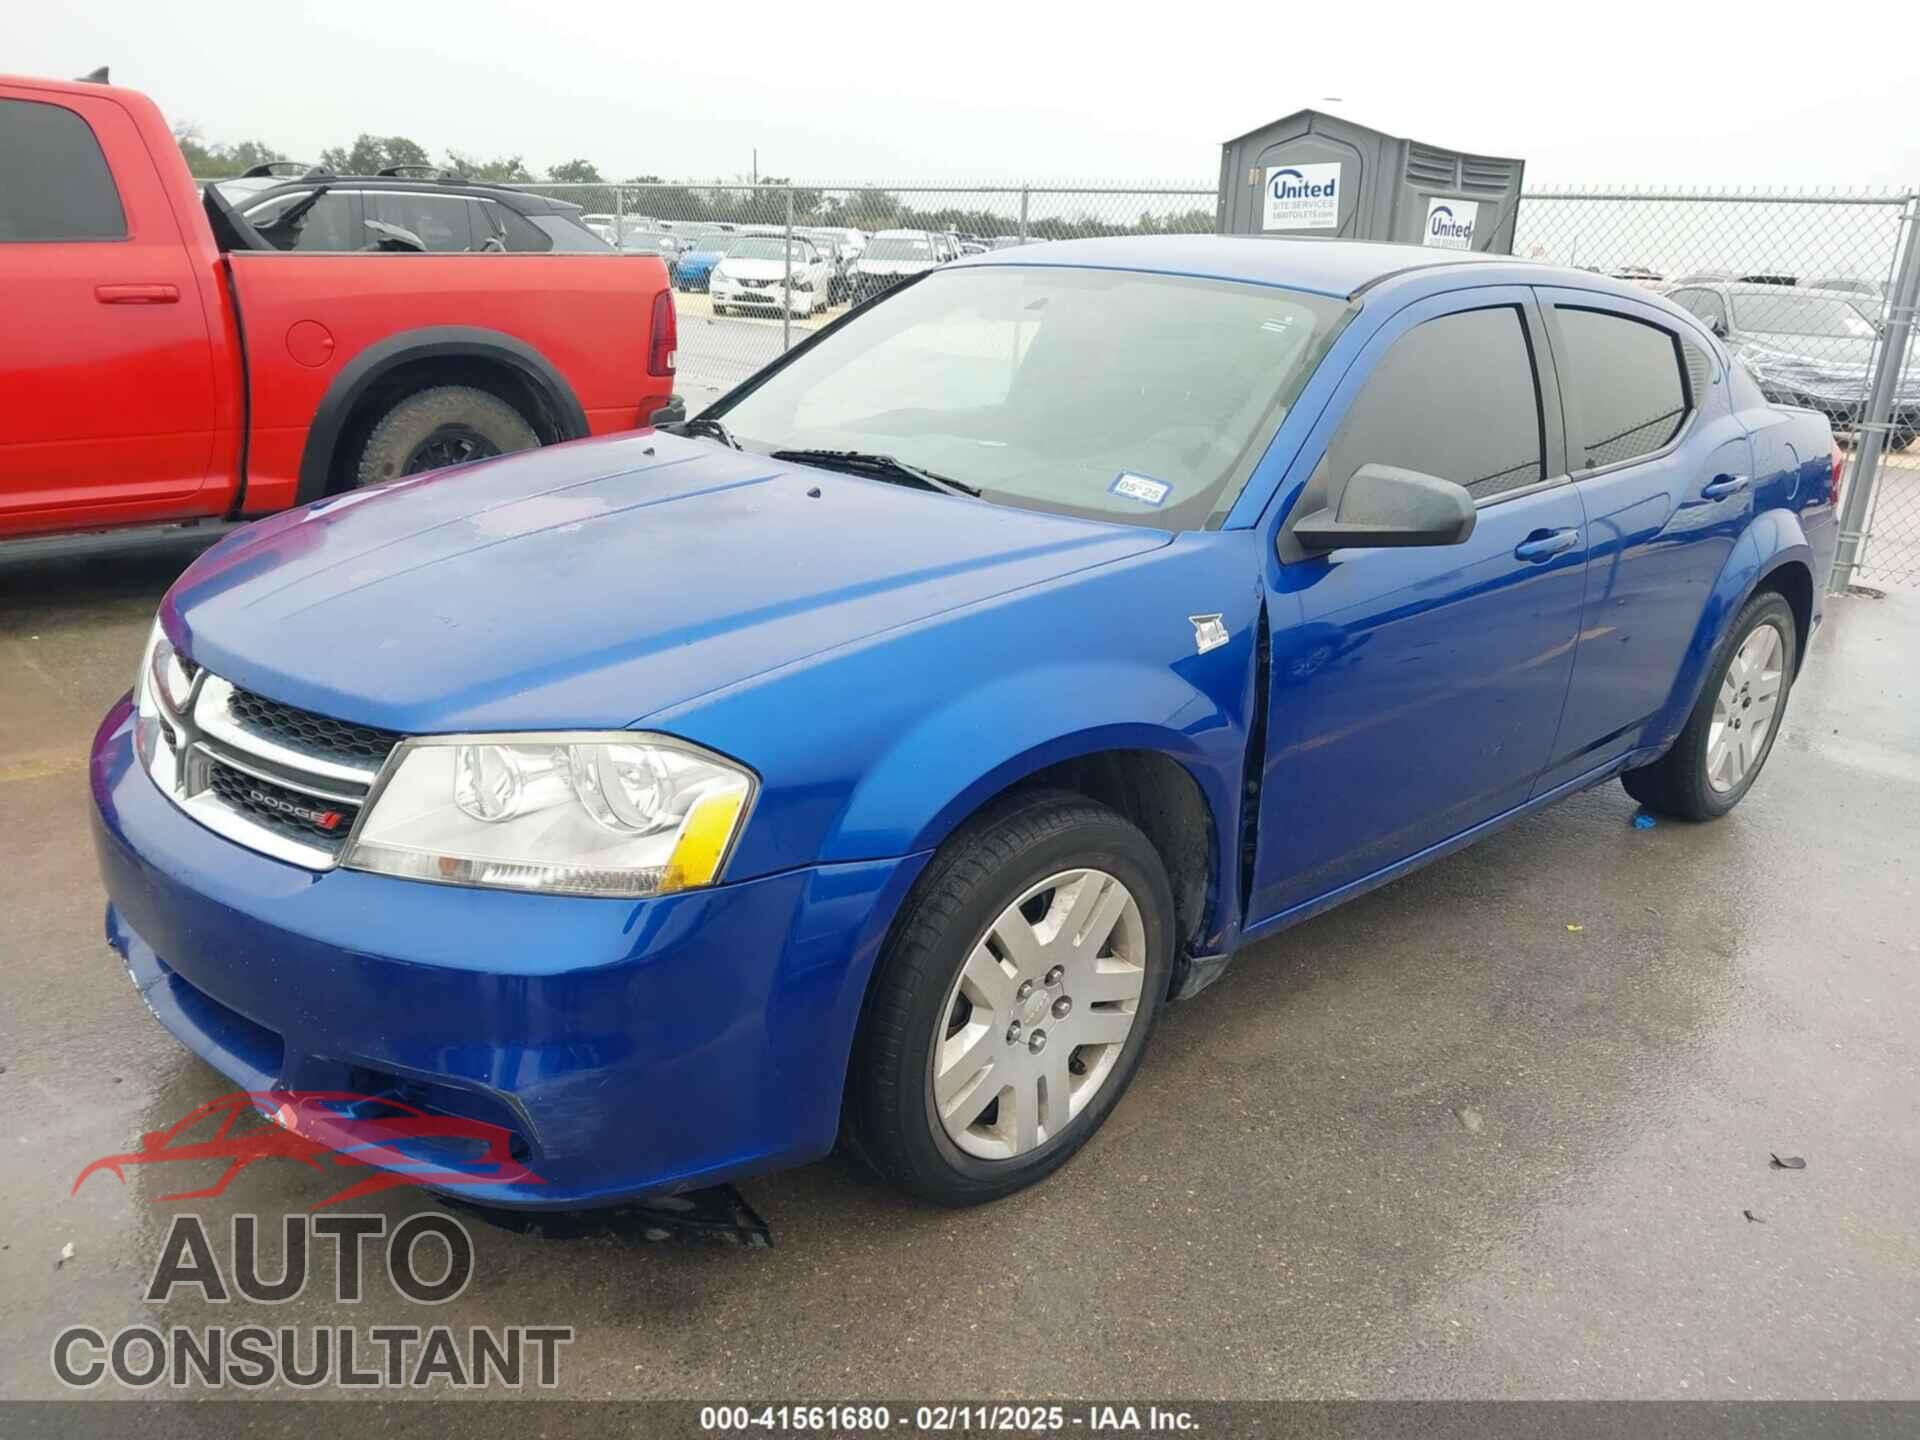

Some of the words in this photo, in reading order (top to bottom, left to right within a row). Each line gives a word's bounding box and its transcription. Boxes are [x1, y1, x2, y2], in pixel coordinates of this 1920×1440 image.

[1274, 178, 1335, 199] United
[1291, 200, 1335, 209] SERVICES
[1432, 217, 1473, 238] United
[250, 788, 325, 824] DODGE
